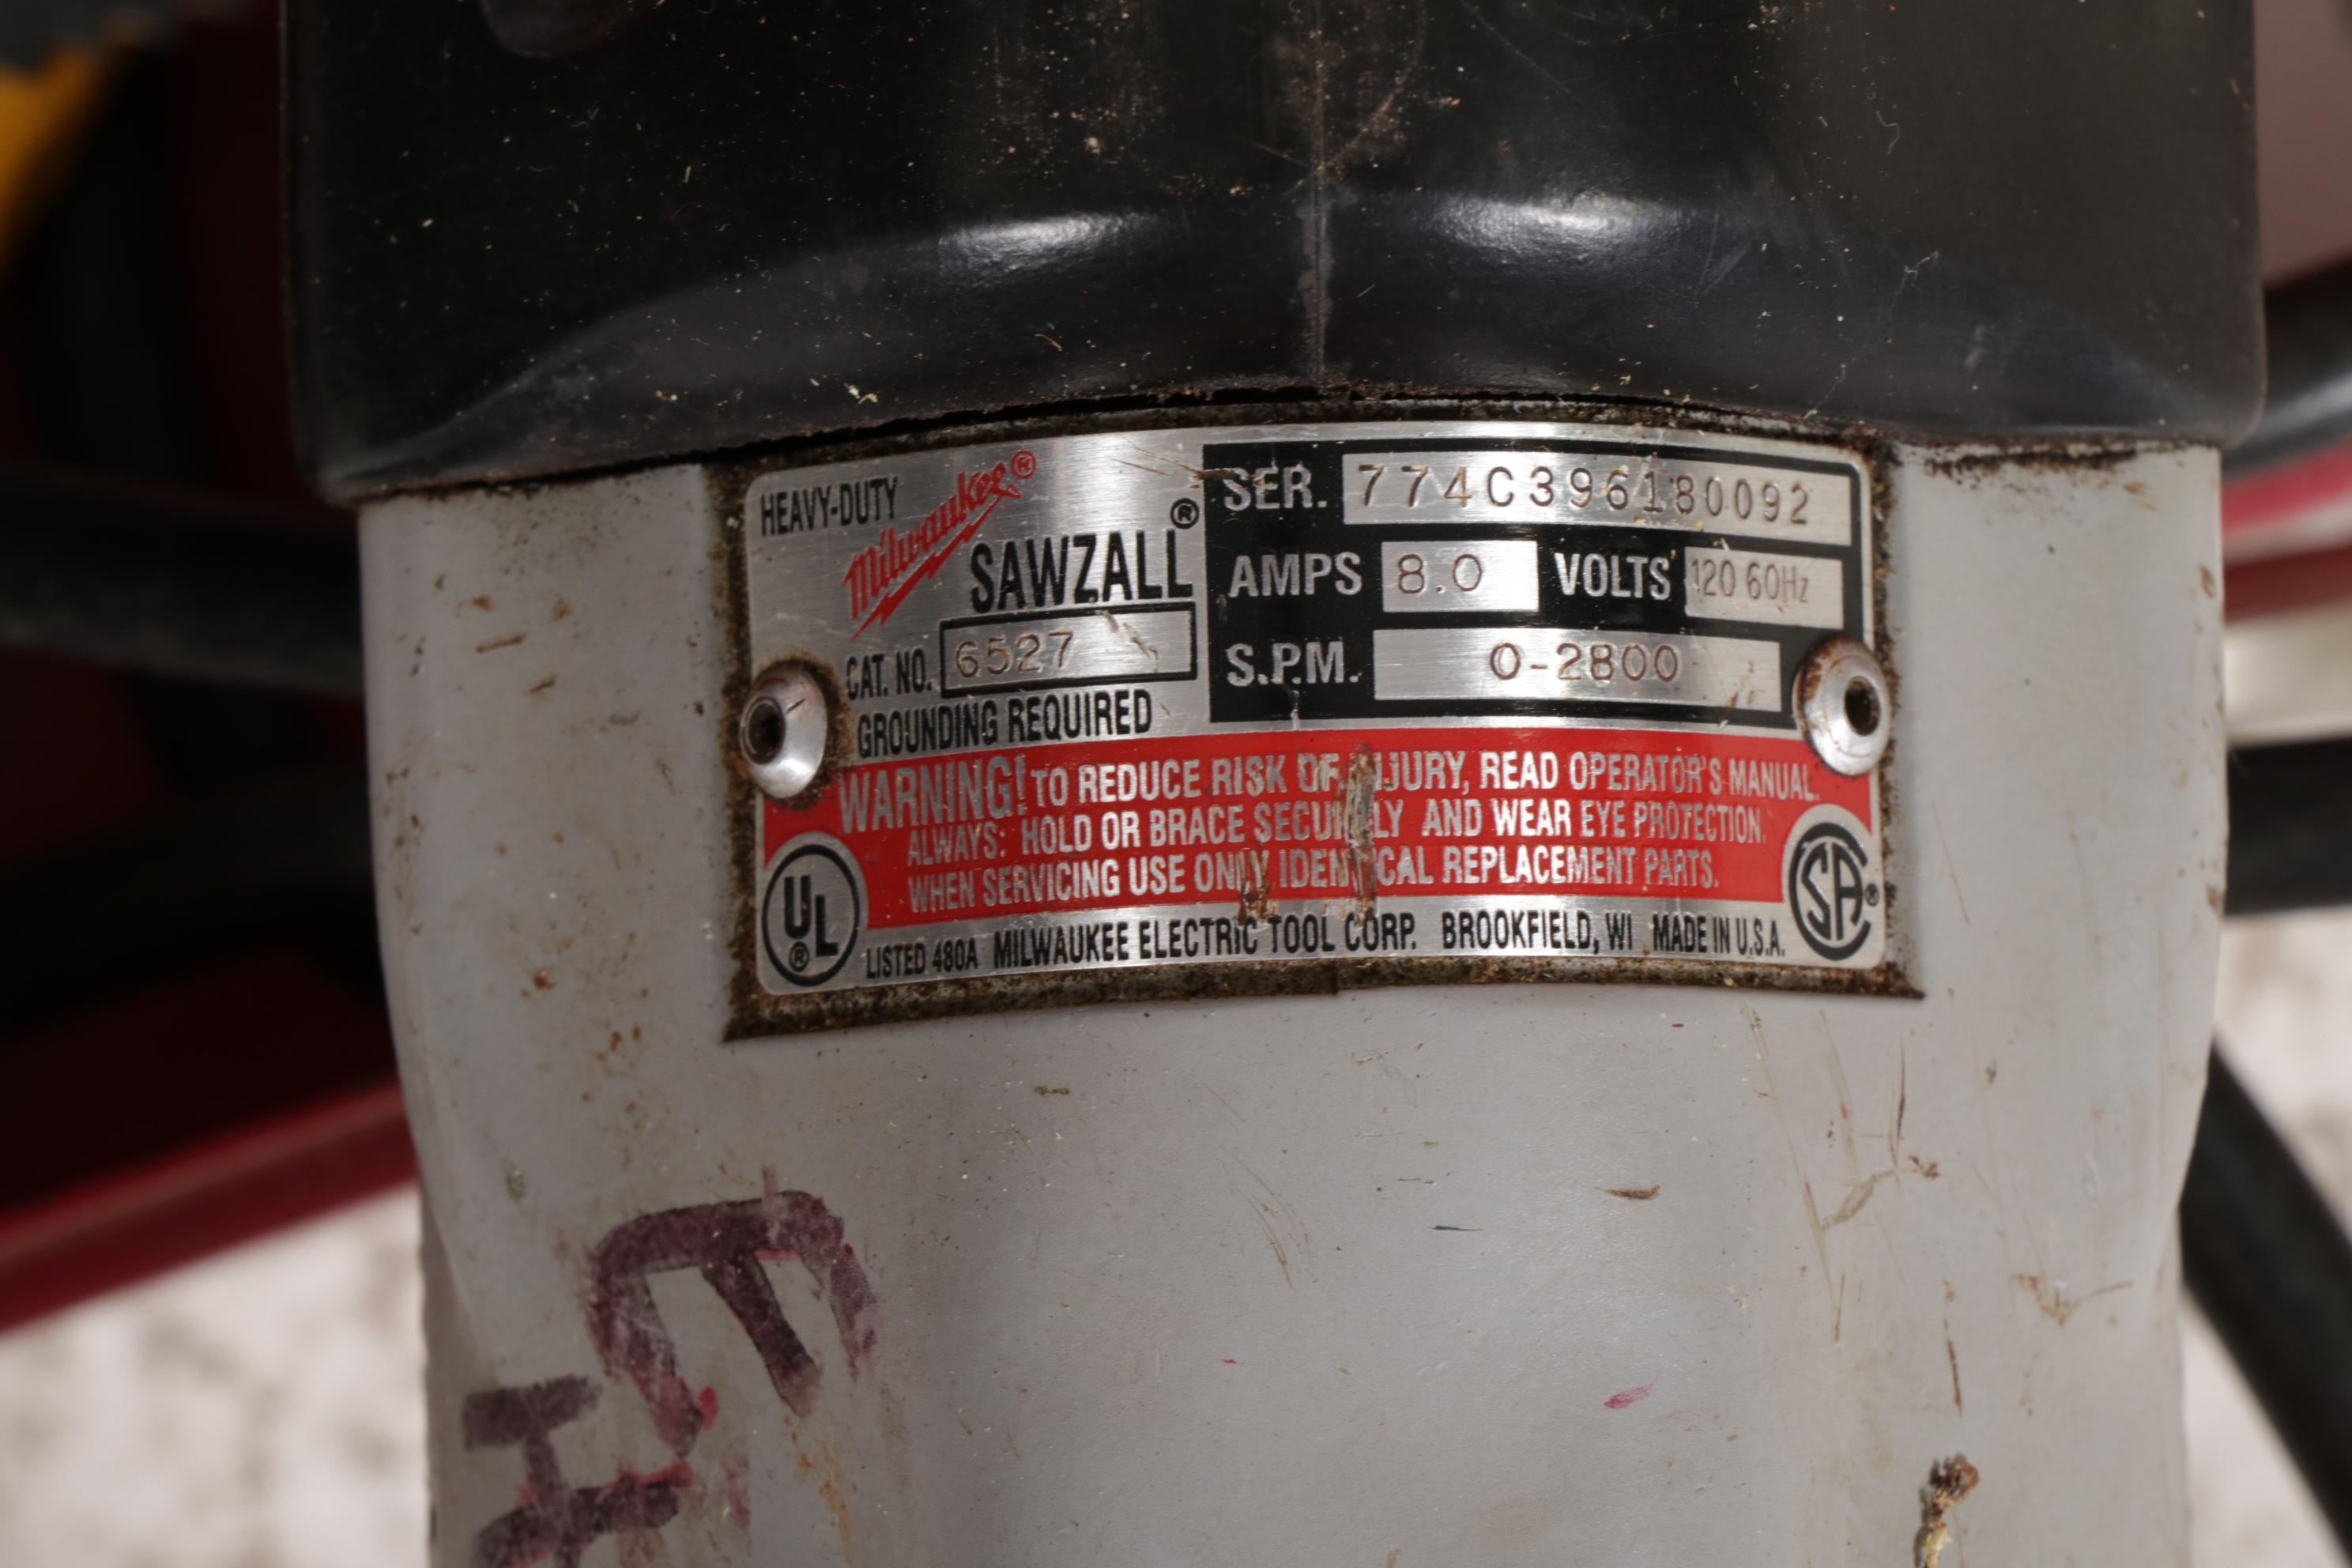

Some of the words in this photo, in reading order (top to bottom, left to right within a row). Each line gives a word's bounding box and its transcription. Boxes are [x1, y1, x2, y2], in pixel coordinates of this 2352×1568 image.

[761, 476, 899, 537] HEAVY-DUTY
[1224, 465, 1328, 511] SER.
[1359, 465, 1808, 524] 774C396180092
[1228, 552, 1363, 597] AMPS
[1396, 553, 1483, 594] 8.0
[1555, 553, 1670, 600] VOLTS
[1691, 560, 1736, 597] 120
[1747, 563, 1808, 604] 60Hz
[846, 652, 888, 697] CAT.
[896, 646, 933, 695] NO.
[956, 631, 1073, 680] 6527
[1226, 642, 1359, 687] S.P.M.
[1491, 643, 1679, 682] 0-2800
[858, 699, 998, 760] GROUNDING
[1008, 688, 1152, 742] REQUIRED
[839, 755, 1027, 834] WARNING!
[1031, 767, 1069, 806] TO
[1079, 759, 1200, 803] REDUCE
[1212, 755, 1287, 796] RISK
[1297, 752, 1340, 793] OF
[1479, 751, 1559, 790] READ
[1569, 752, 1721, 795] OPERATOR'S
[1728, 760, 1820, 801] MANUAL.
[907, 820, 1007, 867] ALWAYS:
[1021, 814, 1092, 855] HOLD
[1101, 810, 1140, 850] OR
[1150, 804, 1245, 846] BRACE
[1421, 797, 1483, 838] AND
[1493, 798, 1571, 837] WEAR
[1581, 801, 1626, 838] EYE
[1634, 805, 1767, 844] PROTECTION.
[908, 869, 975, 914] WHEN
[982, 859, 1120, 906] SERVICING
[1129, 854, 1185, 895] USE
[1442, 846, 1636, 885] REPLACEMENT
[1644, 849, 1719, 888] PARTS.
[782, 874, 839, 958] UL
[993, 919, 1129, 969] MILWAUKEE
[1139, 914, 1259, 960] ELECTRIC
[1267, 913, 1336, 953] TOOL
[1344, 910, 1417, 952] CORP.
[1442, 909, 1600, 955] BROOKFIELD,
[1605, 912, 1633, 951] WI
[1653, 914, 1708, 953] MADE
[1713, 916, 1730, 955] IN
[1738, 918, 1786, 956] U.S.A.
[866, 942, 927, 979] LISTED
